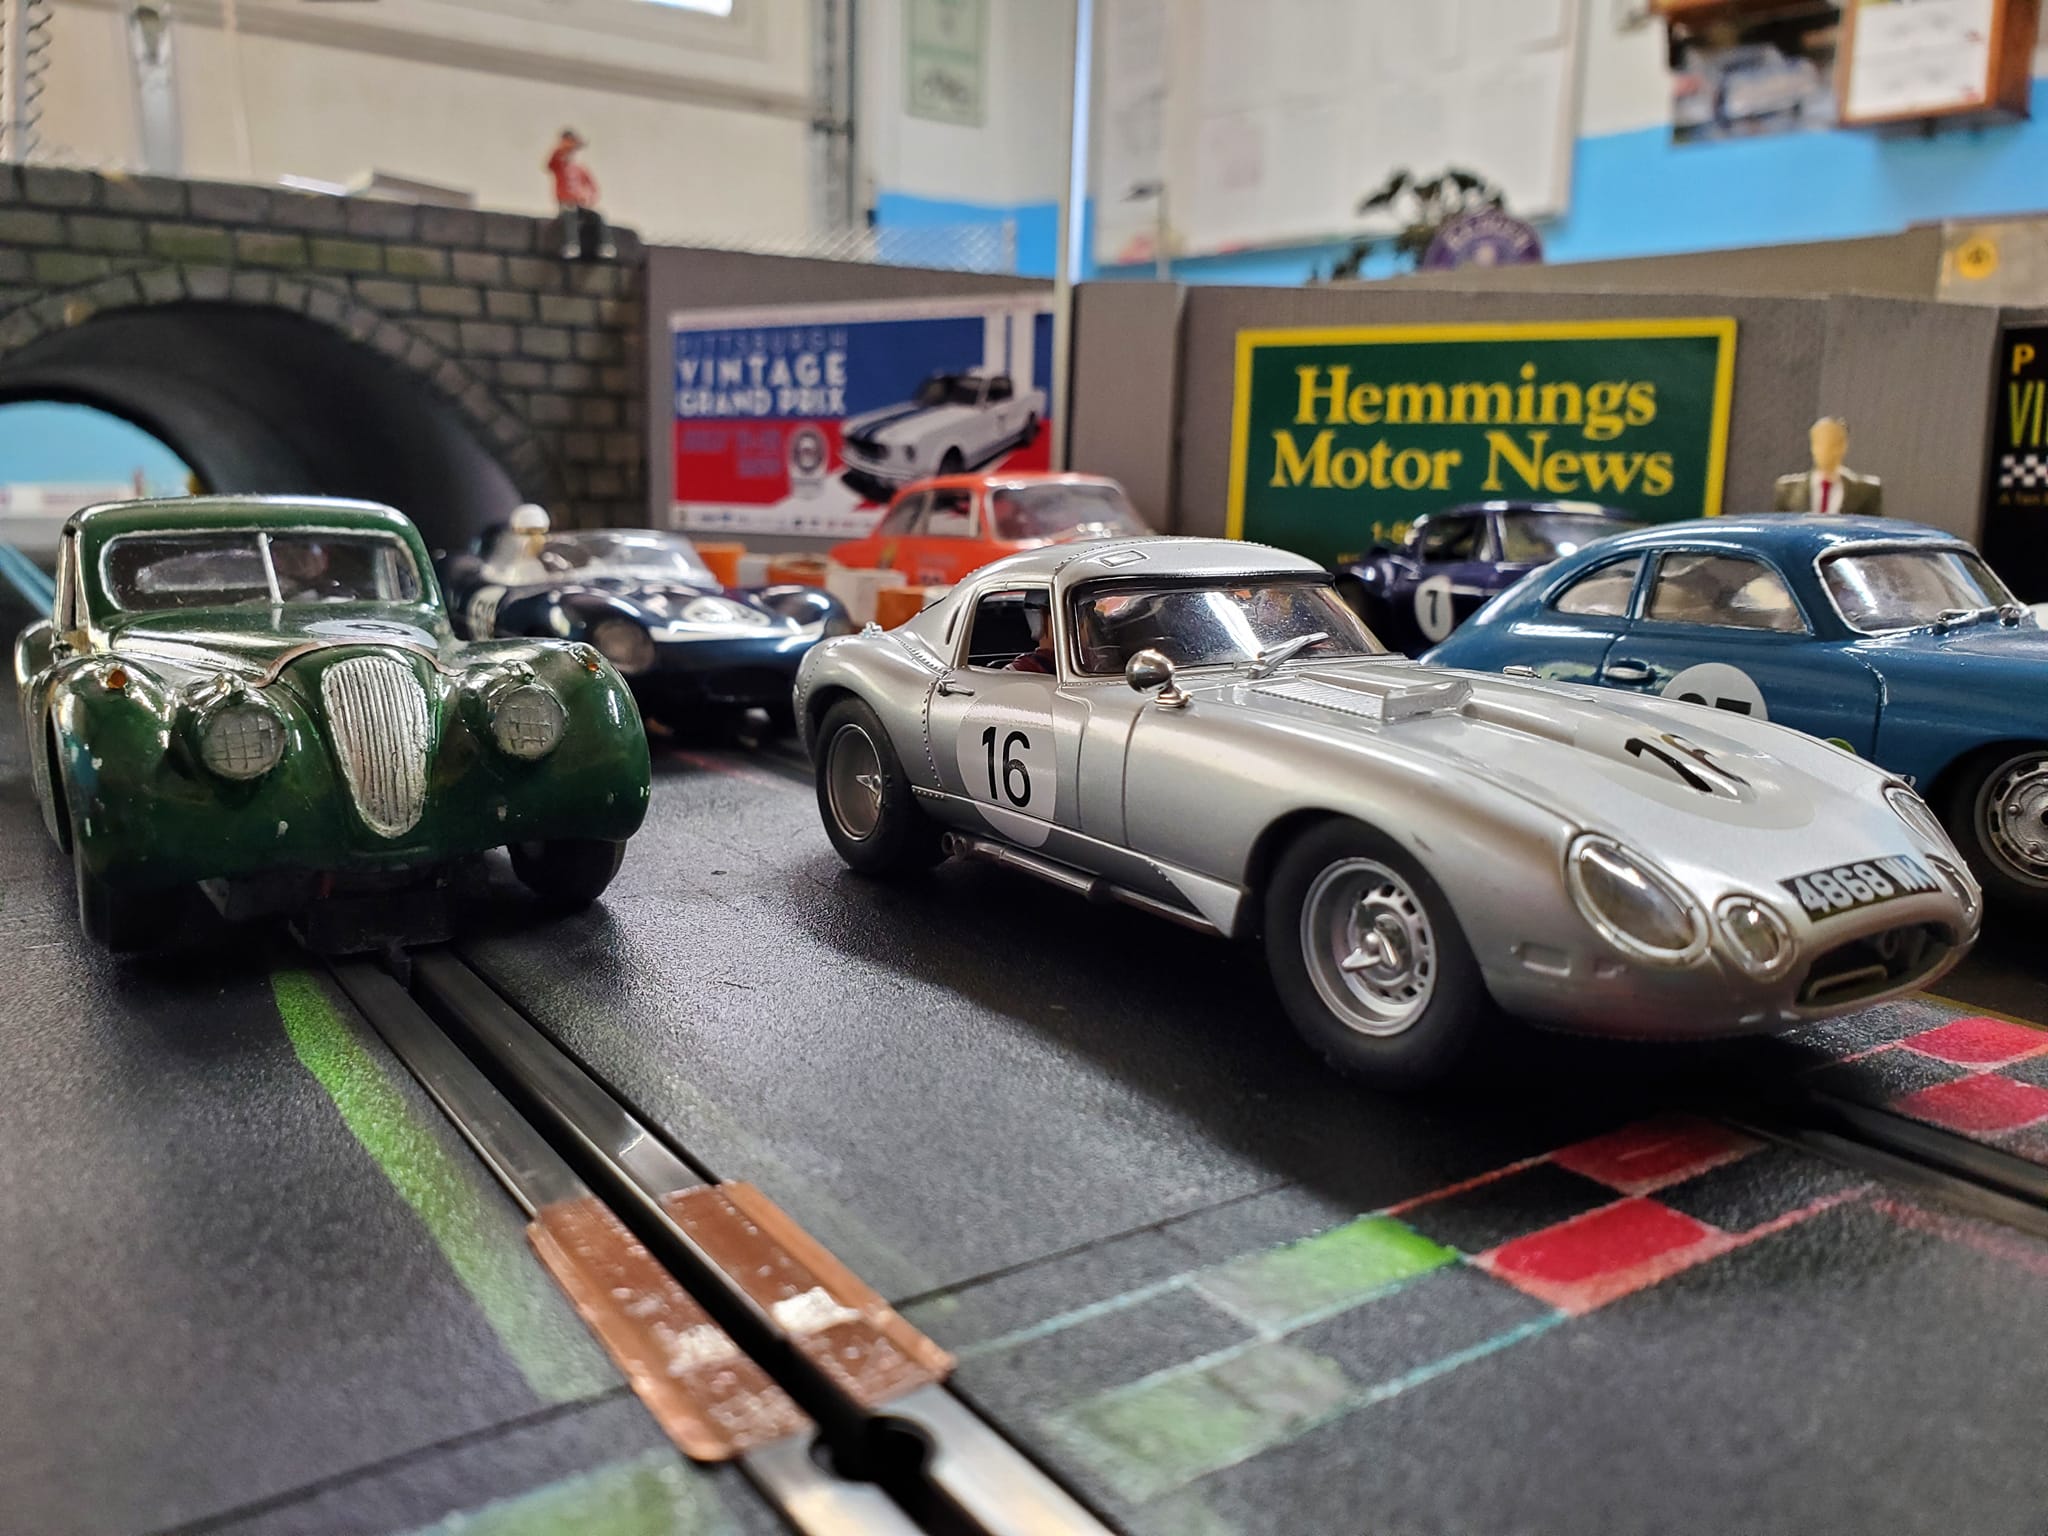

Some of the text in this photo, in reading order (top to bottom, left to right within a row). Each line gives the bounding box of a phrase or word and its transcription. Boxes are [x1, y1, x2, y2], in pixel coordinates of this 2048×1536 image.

[678, 351, 848, 388] VINTAGE
[679, 384, 847, 417] GRAND PRIX
[1295, 362, 1657, 440] Hemmings
[2009, 380, 2048, 447] VI
[1269, 430, 1676, 497] Motor News
[1425, 589, 1438, 628] 7
[982, 726, 1031, 808] 16
[1794, 862, 1896, 913] 4868
